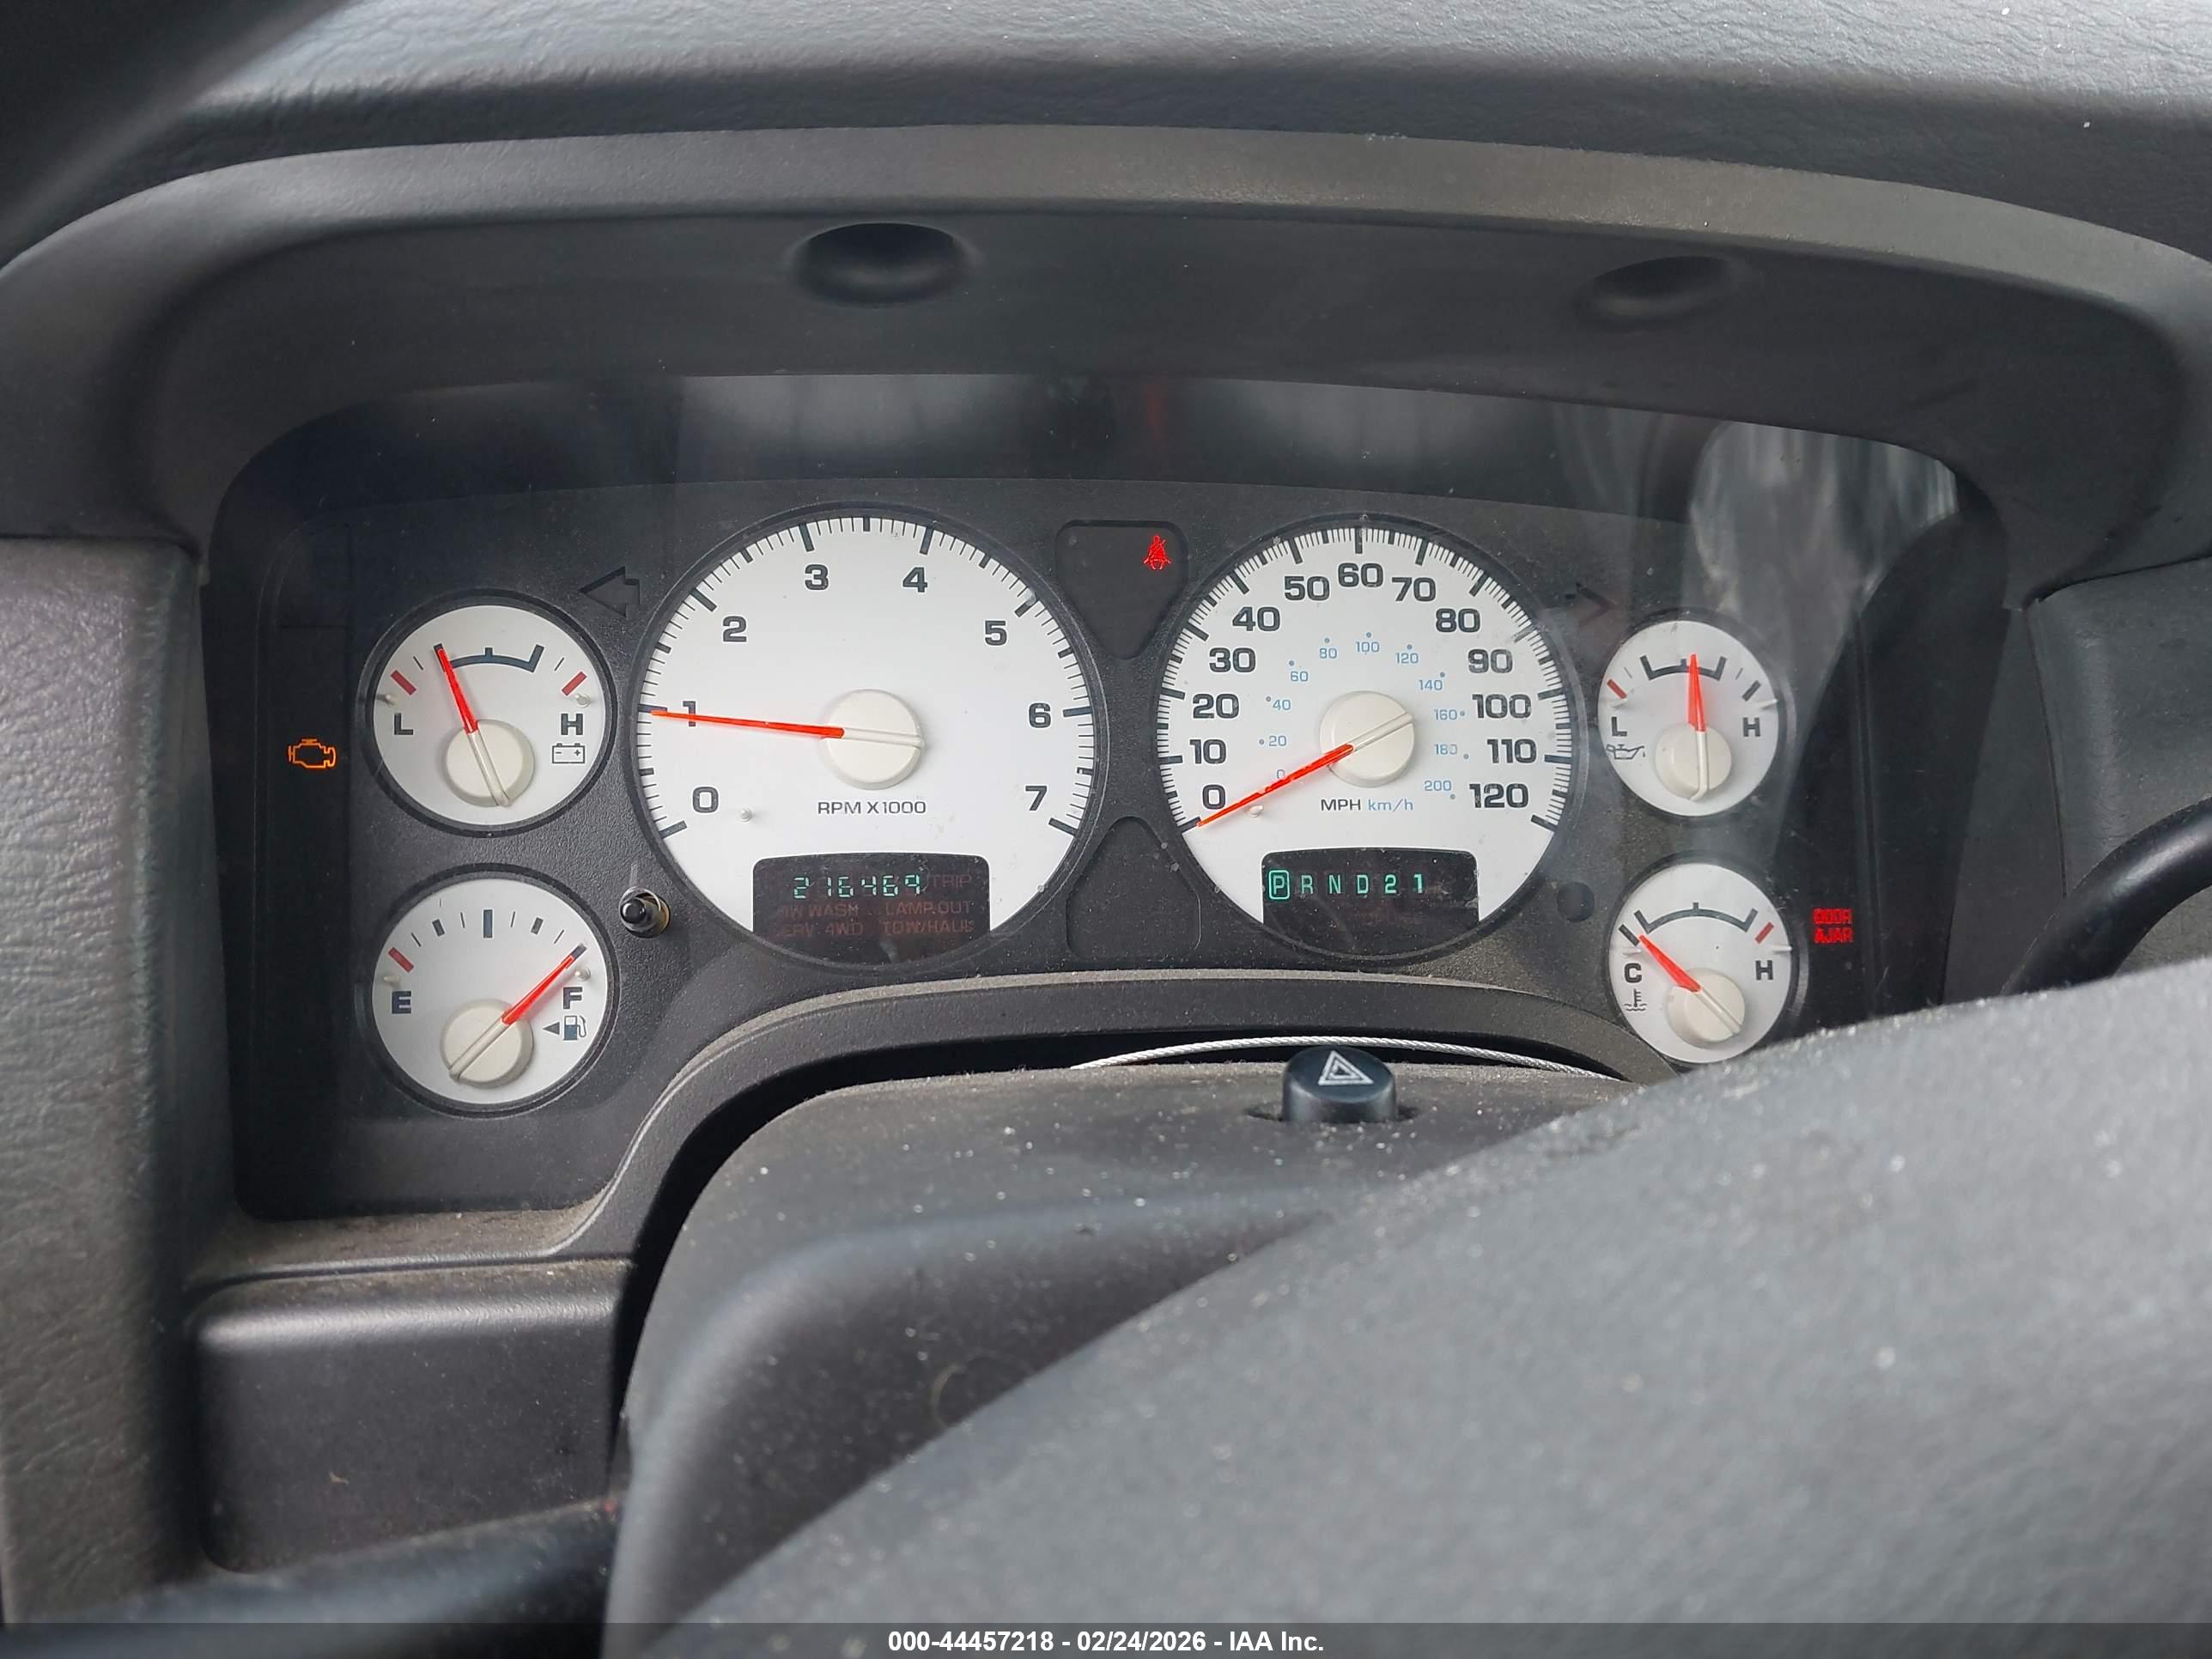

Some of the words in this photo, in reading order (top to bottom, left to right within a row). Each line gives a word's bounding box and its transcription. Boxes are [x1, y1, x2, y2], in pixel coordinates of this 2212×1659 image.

[805, 564, 829, 590] 3
[902, 567, 927, 592] 4
[1338, 563, 1383, 587] 60
[1285, 576, 1329, 600] 50
[1392, 577, 1436, 602] 70
[723, 616, 746, 642] 2
[1232, 607, 1280, 631] 40
[1436, 609, 1480, 633] 80
[985, 621, 1006, 646] 5
[1320, 648, 1337, 659] 80
[1356, 641, 1379, 654] 100
[1396, 653, 1419, 664] 120
[1210, 647, 1255, 672] 30
[1468, 649, 1512, 673] 90
[1291, 672, 1308, 682] 60
[1419, 680, 1443, 690] 140
[683, 701, 696, 726] 1
[1029, 703, 1051, 728] 6
[1193, 694, 1239, 719] 20
[1273, 700, 1291, 710] 40
[1434, 709, 1457, 720] 160
[1473, 694, 1531, 719] 100
[394, 713, 413, 735] L
[561, 714, 583, 735] H
[1611, 717, 1627, 737] L
[1743, 718, 1760, 737] H
[1190, 739, 1226, 764] 10
[1269, 736, 1286, 746] 20
[1435, 744, 1457, 755] 180
[1487, 739, 1536, 763] 110
[1425, 781, 1451, 791] 200
[1469, 783, 1528, 808] 120
[693, 787, 719, 813] 0
[818, 802, 860, 814] RPM
[1025, 786, 1047, 811] 7
[1202, 785, 1227, 811] 0
[1322, 799, 1360, 811] MPH
[1369, 799, 1413, 811] km/h
[793, 875, 921, 898] 216469
[1273, 875, 1285, 894] P
[1302, 875, 1313, 894] R
[1329, 875, 1340, 894] N
[1358, 875, 1369, 893] D
[1385, 874, 1396, 893] 2
[1414, 874, 1422, 893] 1
[1814, 927, 1853, 943] AJAR
[1625, 963, 1642, 983] C
[1755, 960, 1773, 980] H
[392, 991, 411, 1014] E
[562, 985, 582, 1009] F
